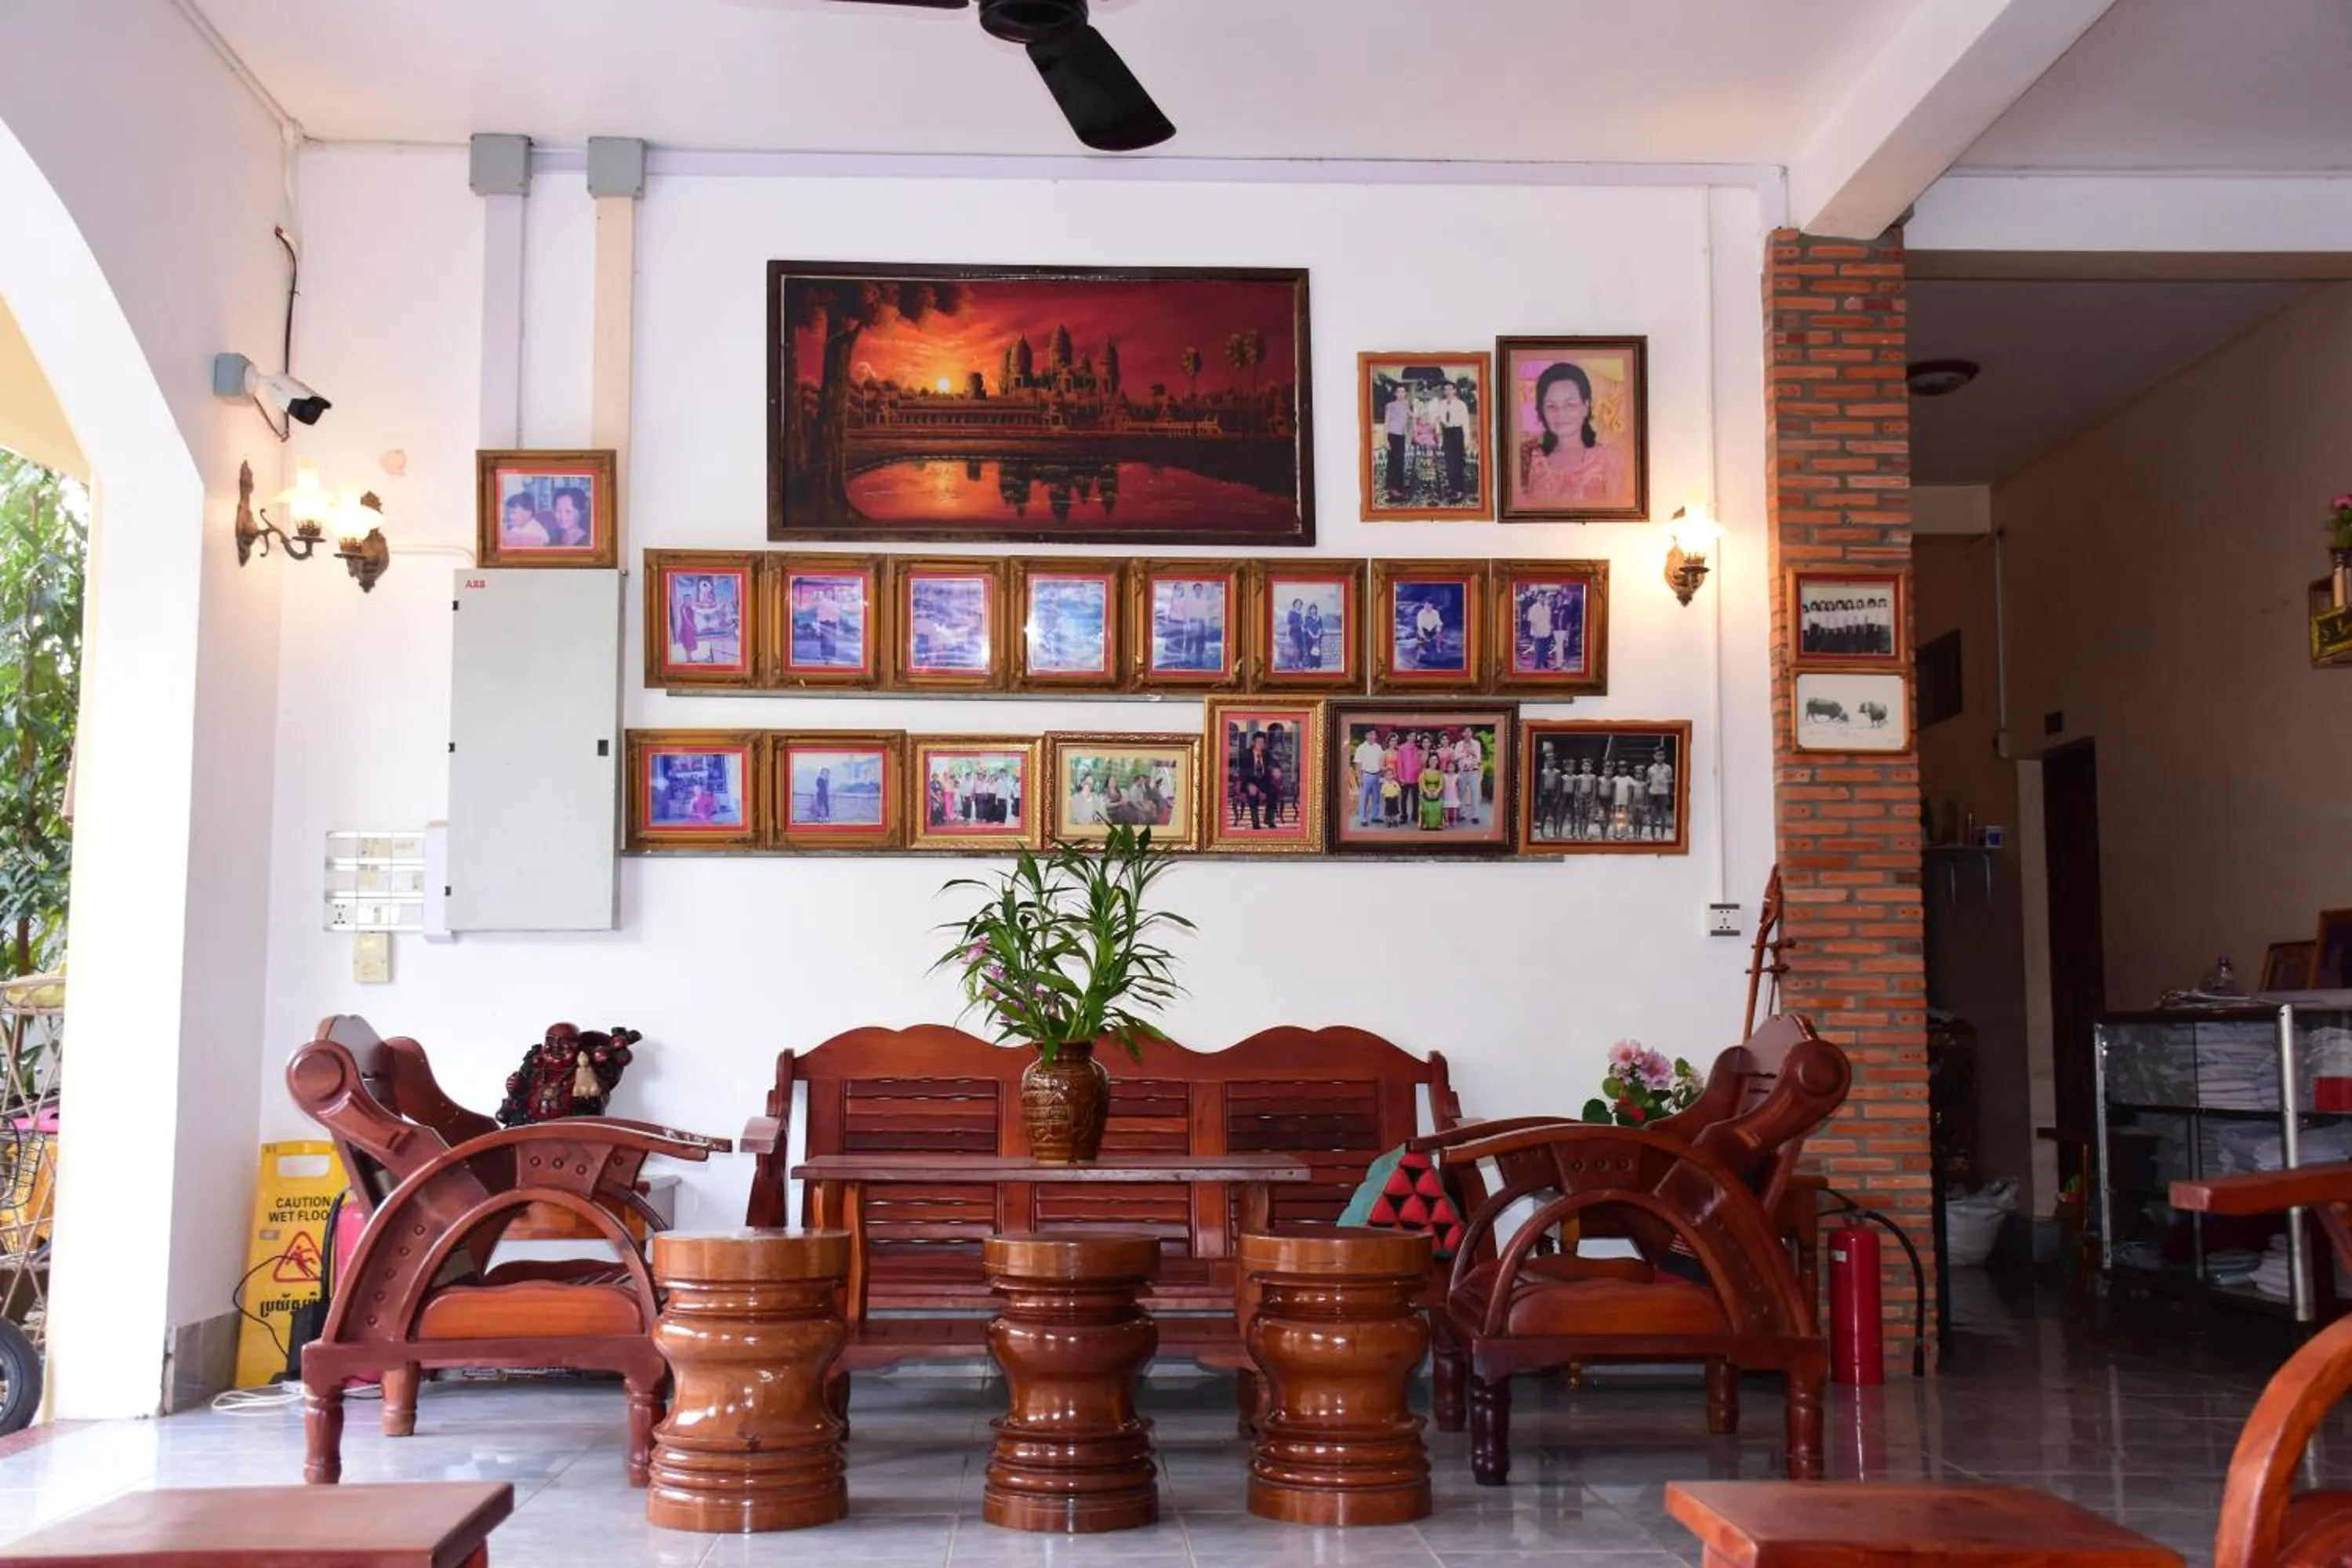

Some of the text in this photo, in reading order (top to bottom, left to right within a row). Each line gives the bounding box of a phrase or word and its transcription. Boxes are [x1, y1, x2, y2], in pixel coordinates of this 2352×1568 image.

[276, 1196, 330, 1208] CAUTION
[269, 1210, 328, 1222] WET FLOO
